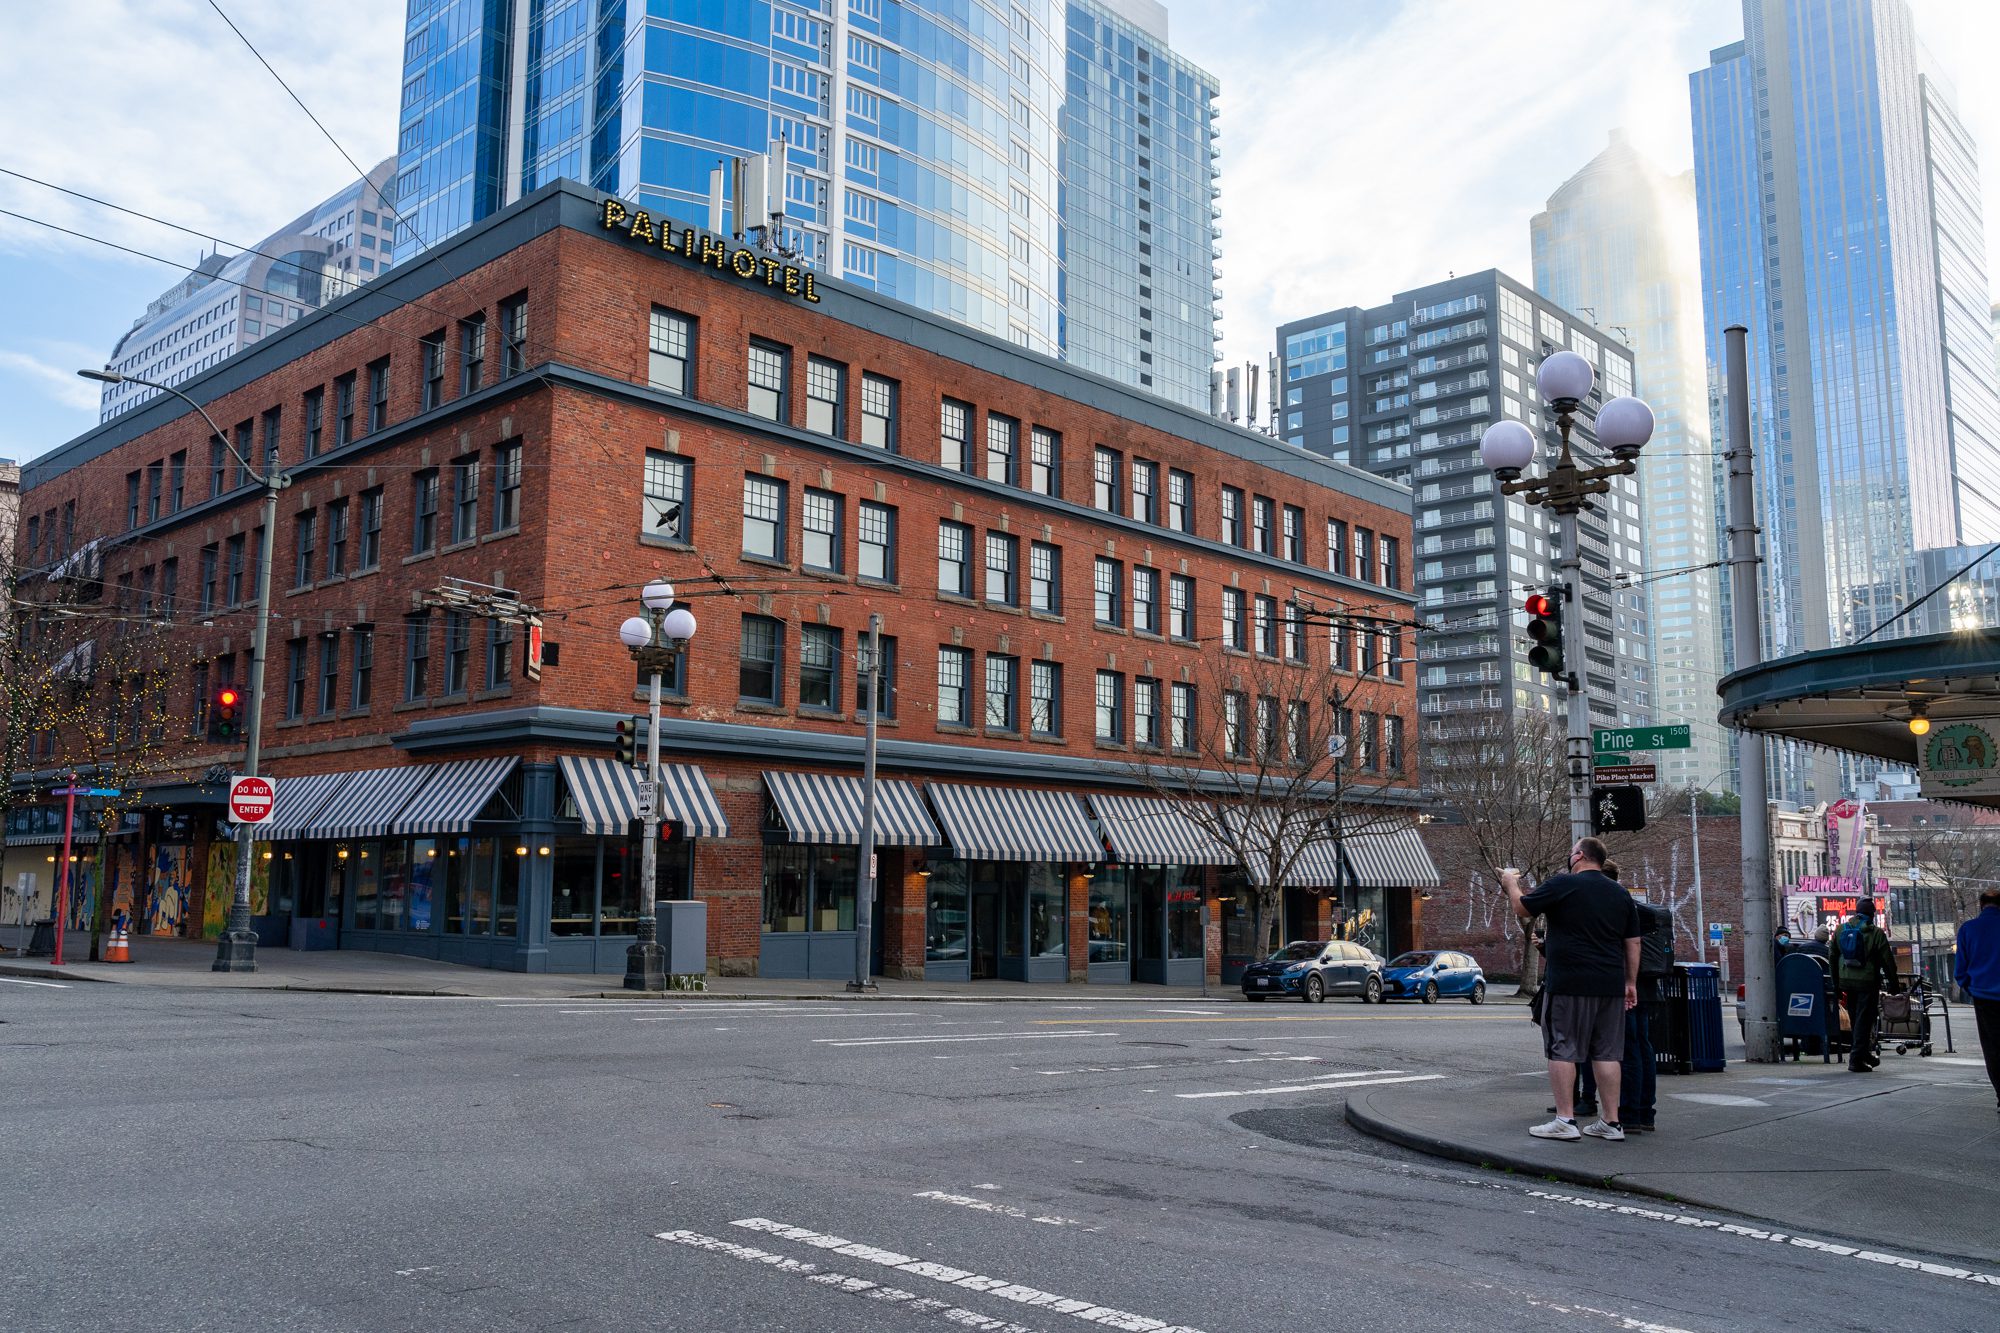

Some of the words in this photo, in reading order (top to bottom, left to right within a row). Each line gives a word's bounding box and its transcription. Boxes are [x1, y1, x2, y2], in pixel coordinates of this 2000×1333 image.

[603, 199, 821, 303] PALIHOTEL
[1670, 726, 1689, 735] 1500
[1601, 732, 1634, 749] Pine
[1652, 734, 1665, 747] St
[1629, 772, 1654, 780] Market
[238, 786, 249, 794] DO
[253, 786, 268, 794] NOT
[641, 784, 652, 793] ONE
[640, 794, 652, 802] WAY
[239, 806, 264, 814] ENTER
[1797, 876, 1863, 893] SHOWGIRLS
